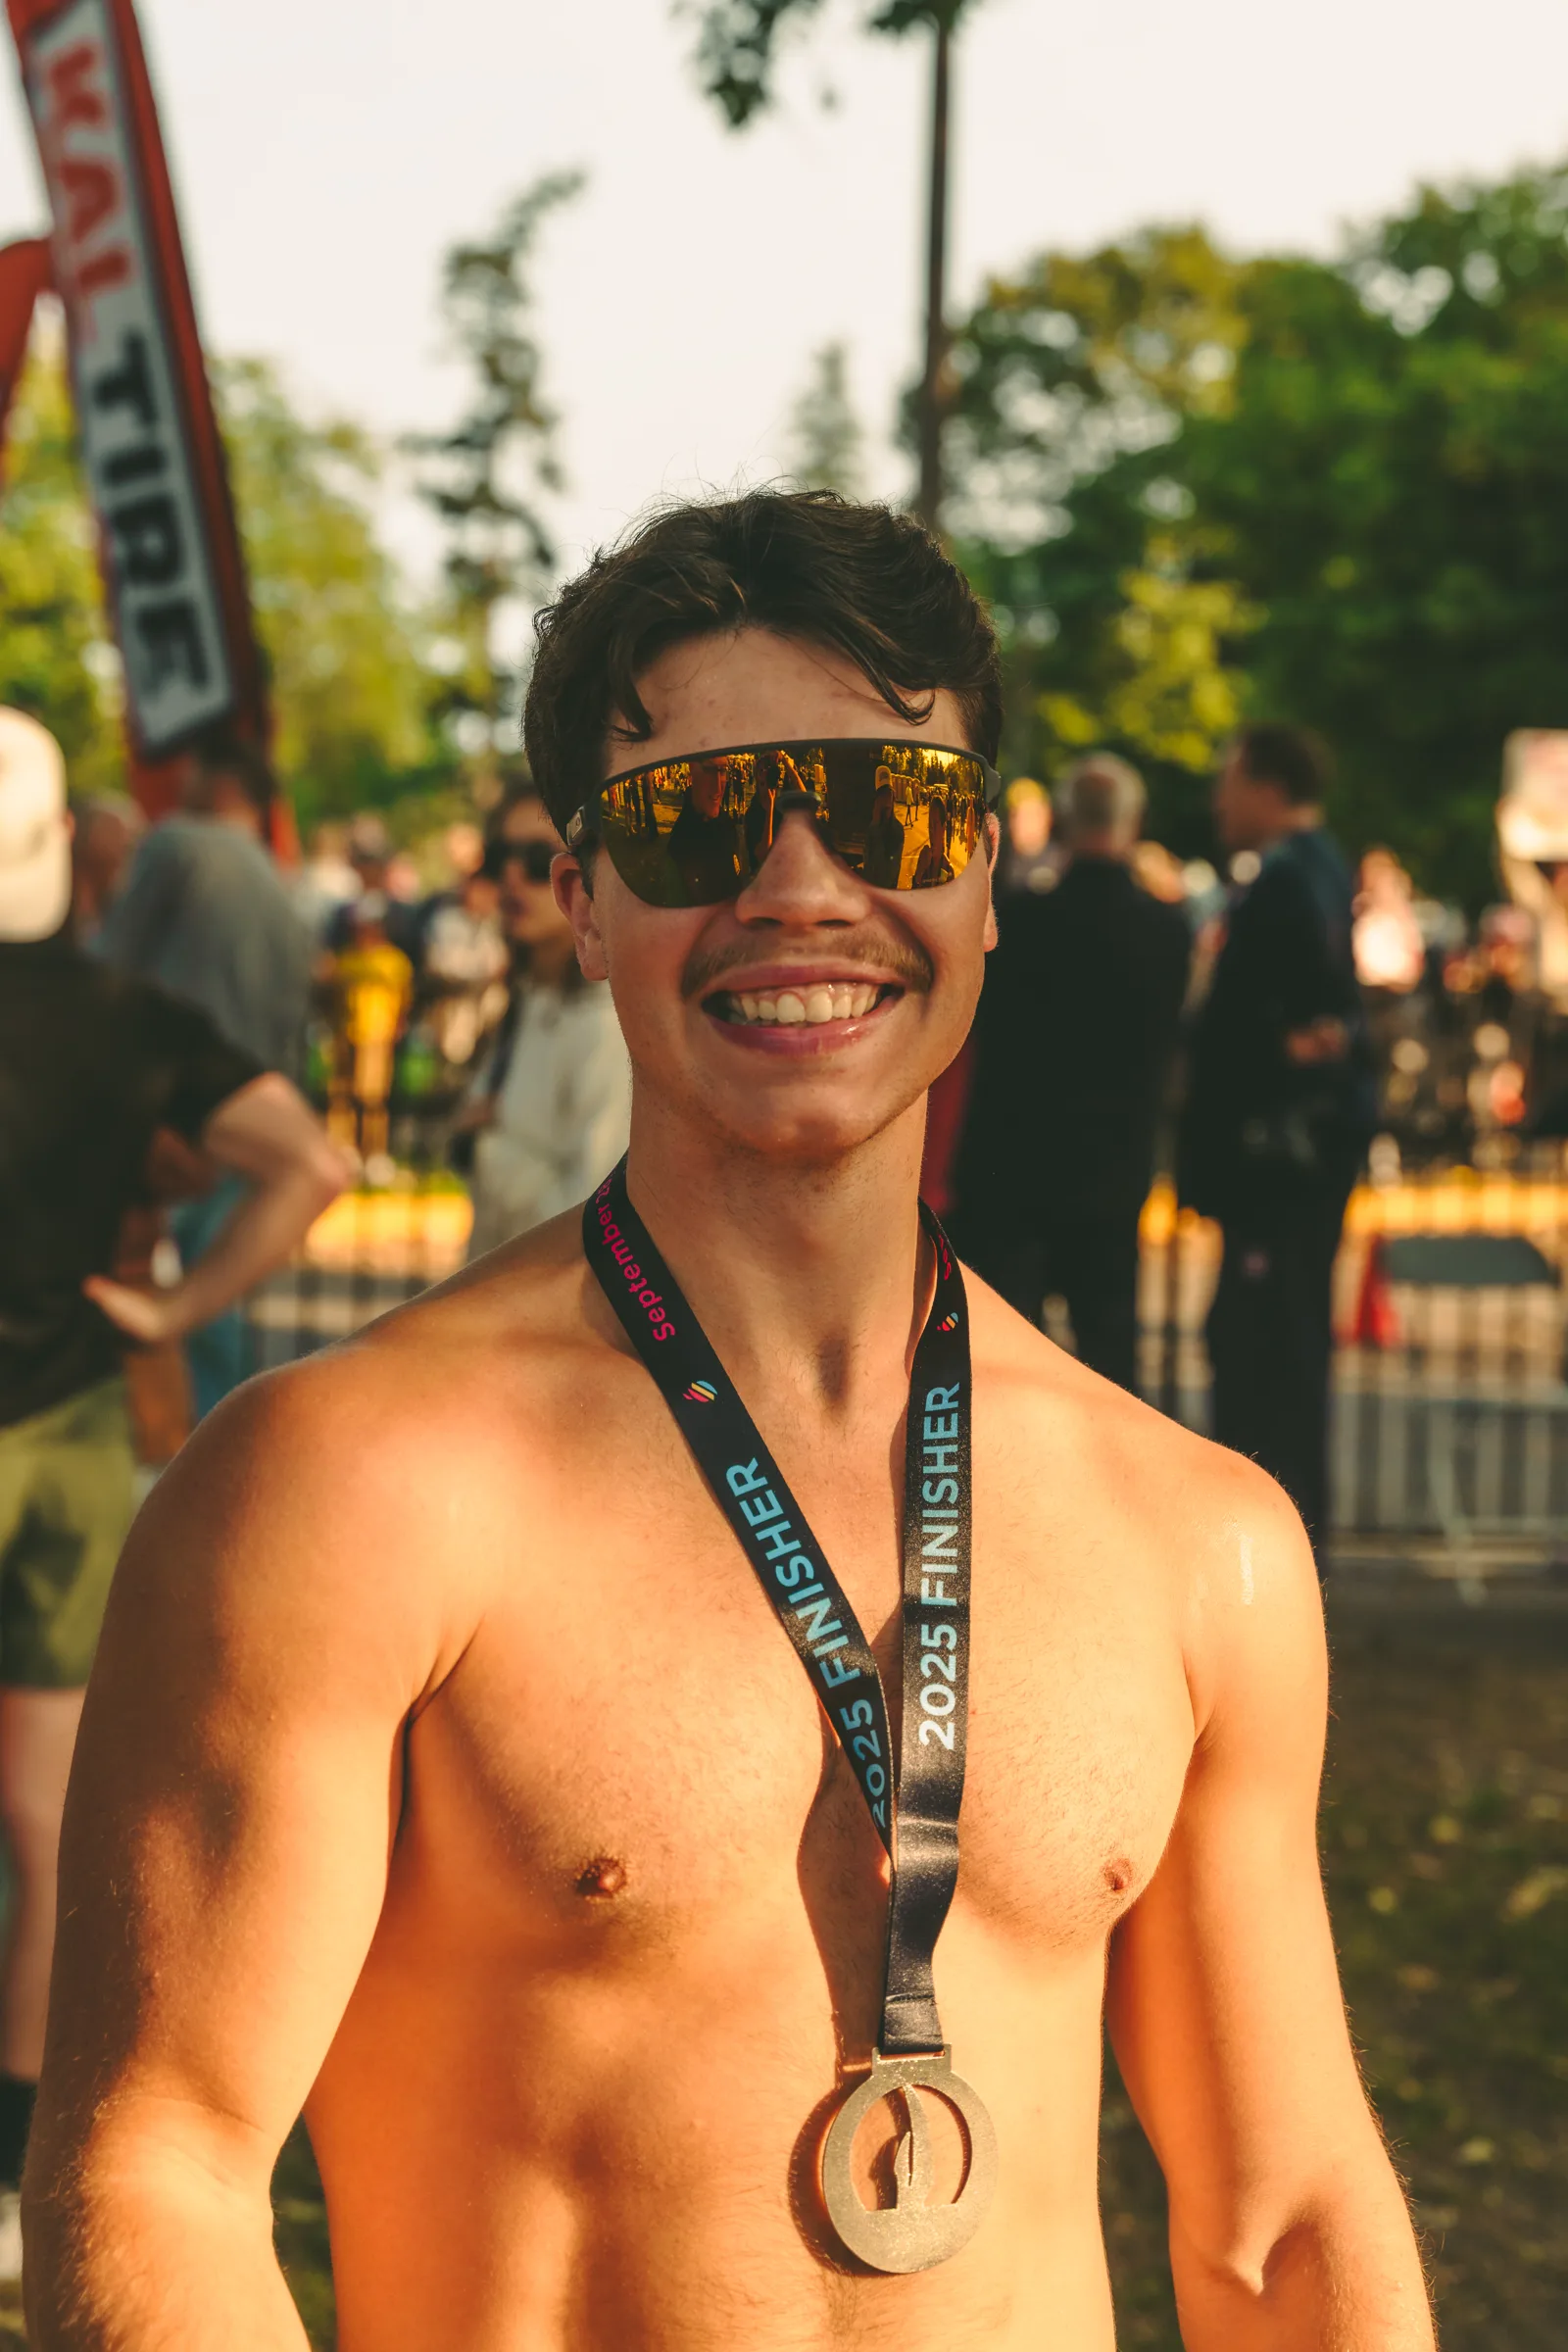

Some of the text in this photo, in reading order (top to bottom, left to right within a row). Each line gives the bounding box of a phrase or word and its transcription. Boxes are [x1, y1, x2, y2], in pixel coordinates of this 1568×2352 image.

[597, 1203, 675, 1342] September
[725, 1456, 887, 1830] 2025 FINISHER
[918, 1382, 960, 1751] 2025 FINISHER
